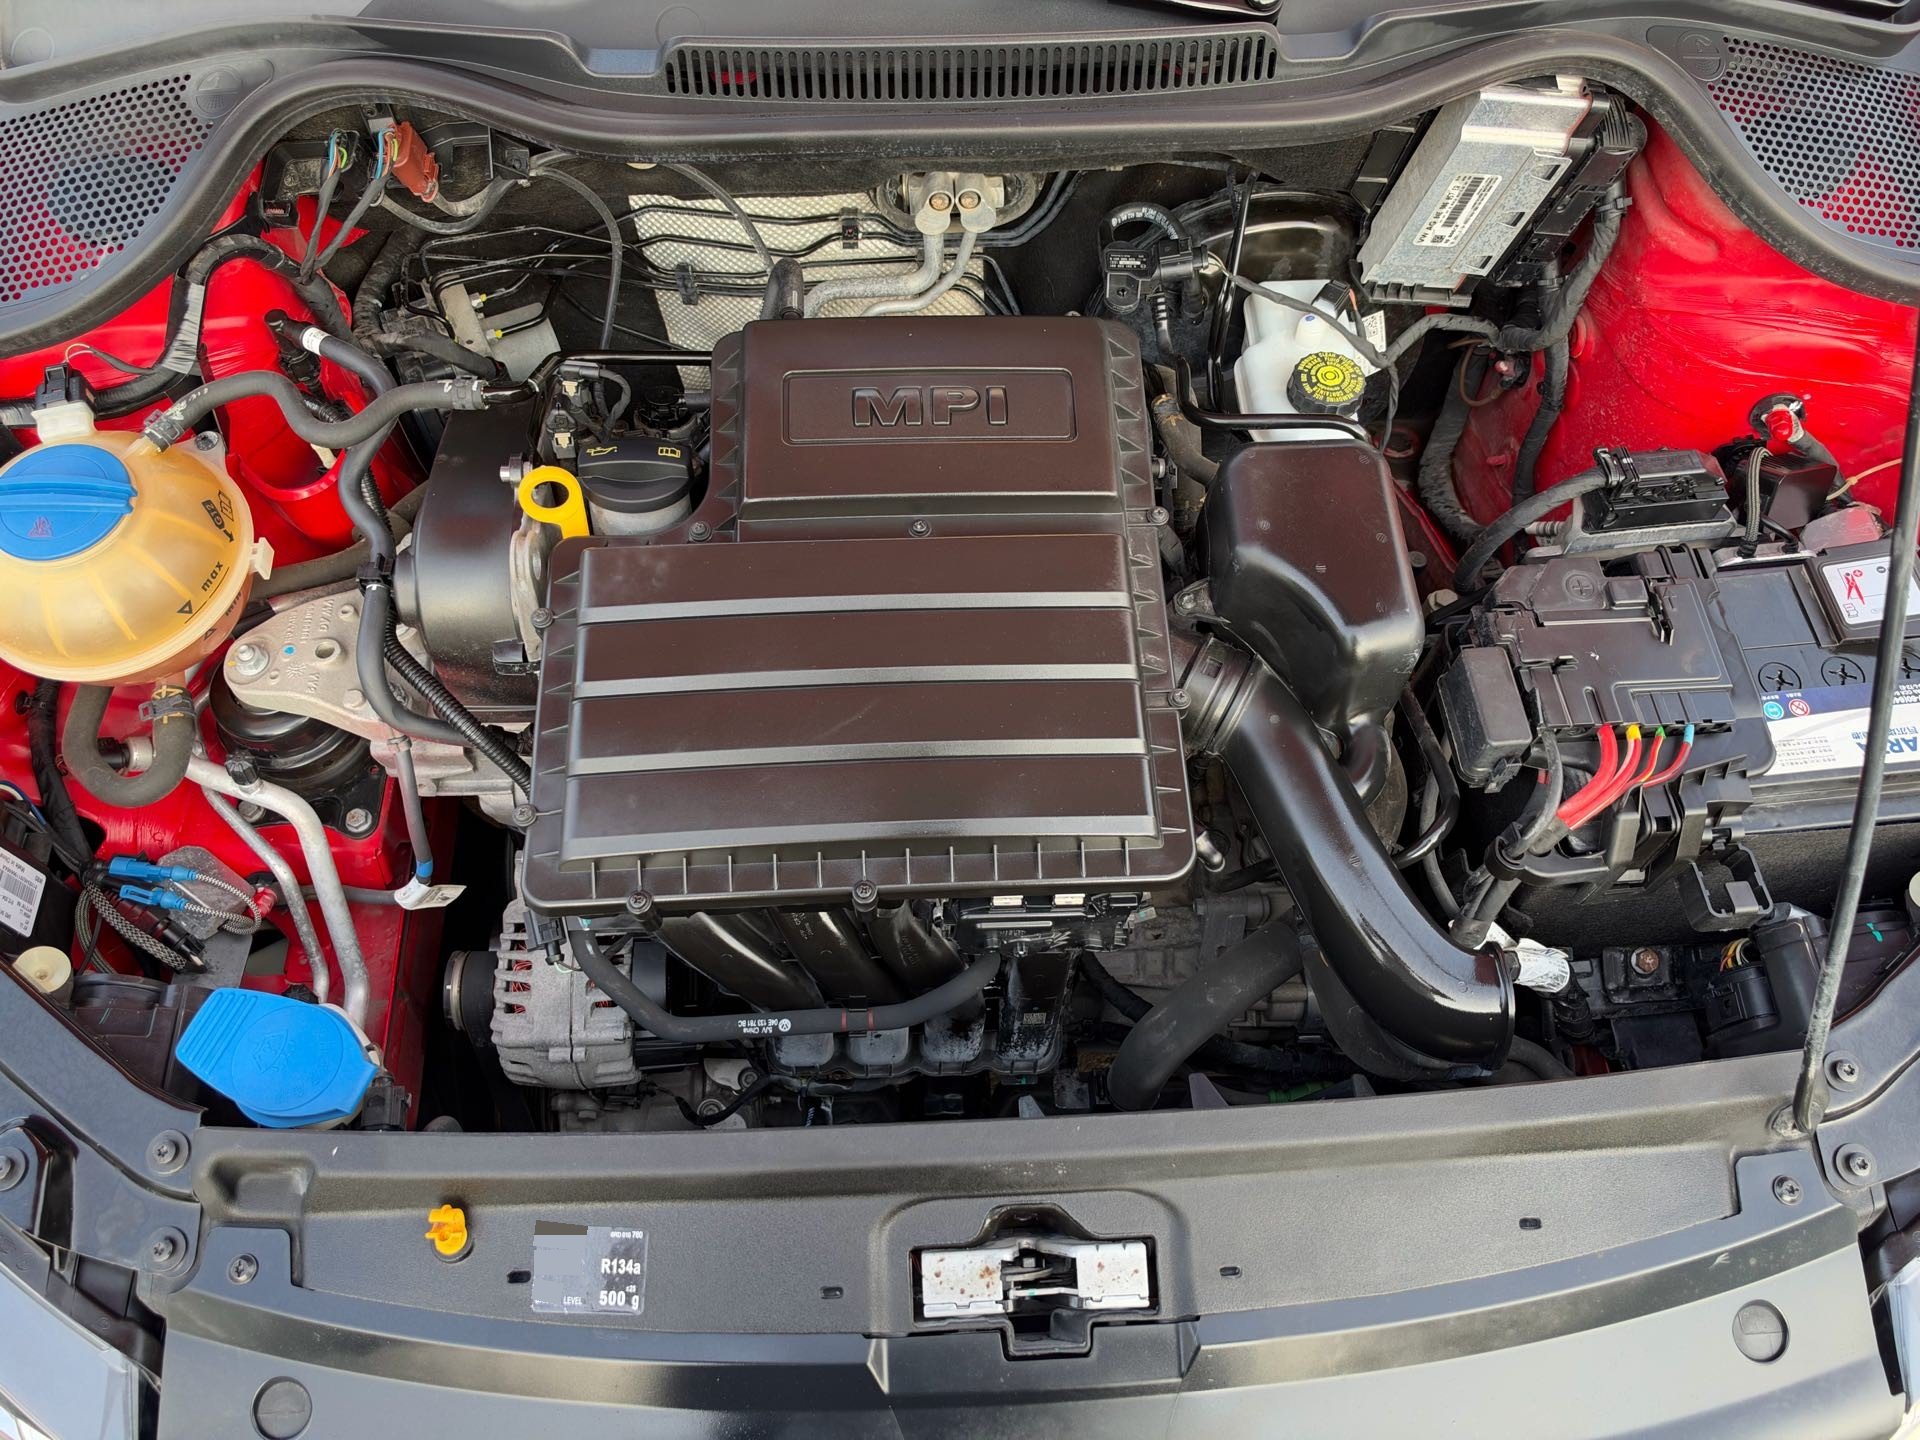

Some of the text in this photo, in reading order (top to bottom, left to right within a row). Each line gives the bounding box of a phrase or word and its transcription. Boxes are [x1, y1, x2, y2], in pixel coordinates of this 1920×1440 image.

[852, 385, 1010, 428] MPI
[206, 503, 222, 525] G12
[201, 560, 224, 592] max
[601, 1258, 641, 1275] R134a
[563, 1296, 583, 1305] LEVEL
[599, 1290, 626, 1306] 500
[631, 1294, 640, 1310] g
